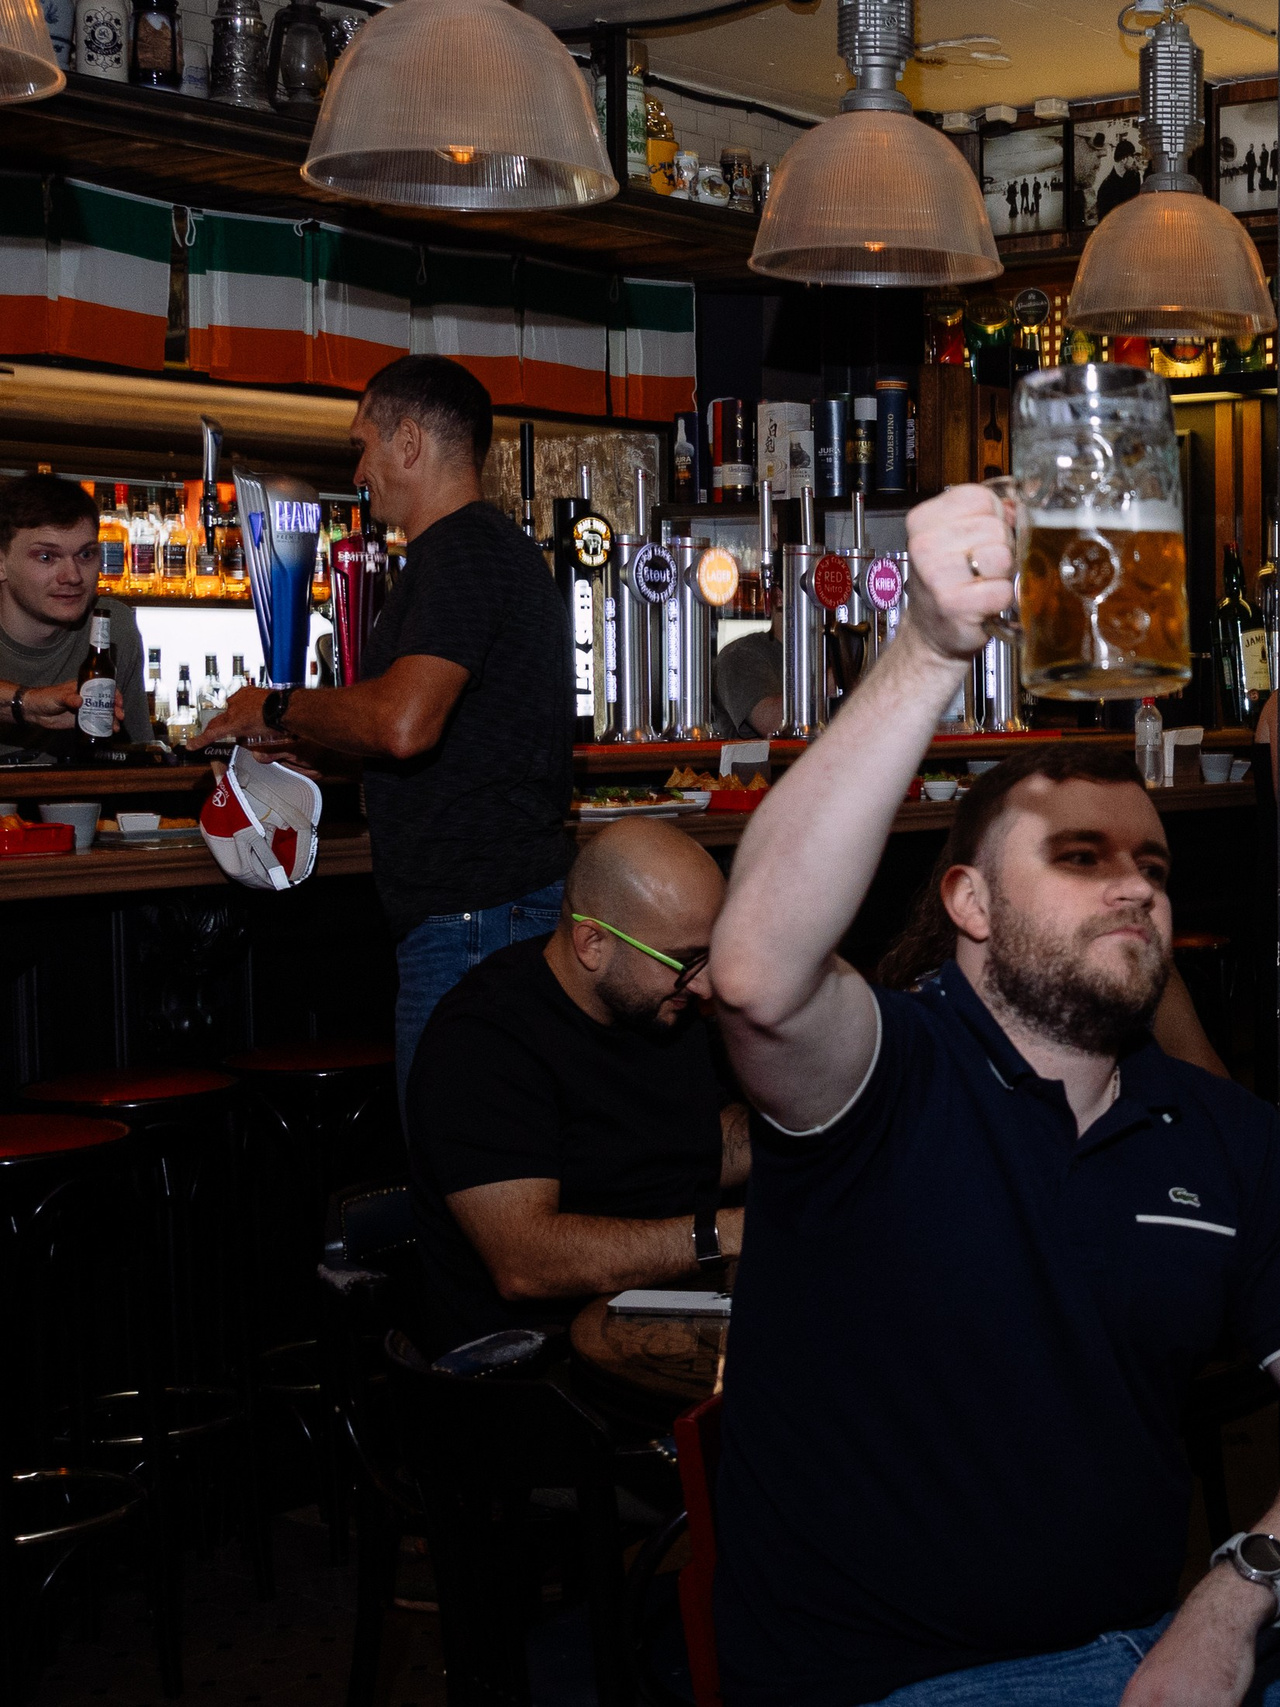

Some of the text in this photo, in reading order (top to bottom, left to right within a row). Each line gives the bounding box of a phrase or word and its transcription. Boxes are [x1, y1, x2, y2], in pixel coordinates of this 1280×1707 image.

[885, 413, 895, 473] VALDESPINO
[275, 501, 321, 534] HARP
[642, 566, 671, 583] Stout
[824, 571, 843, 583] RED
[824, 583, 843, 593] Nitro
[875, 577, 896, 591] KRIEK
